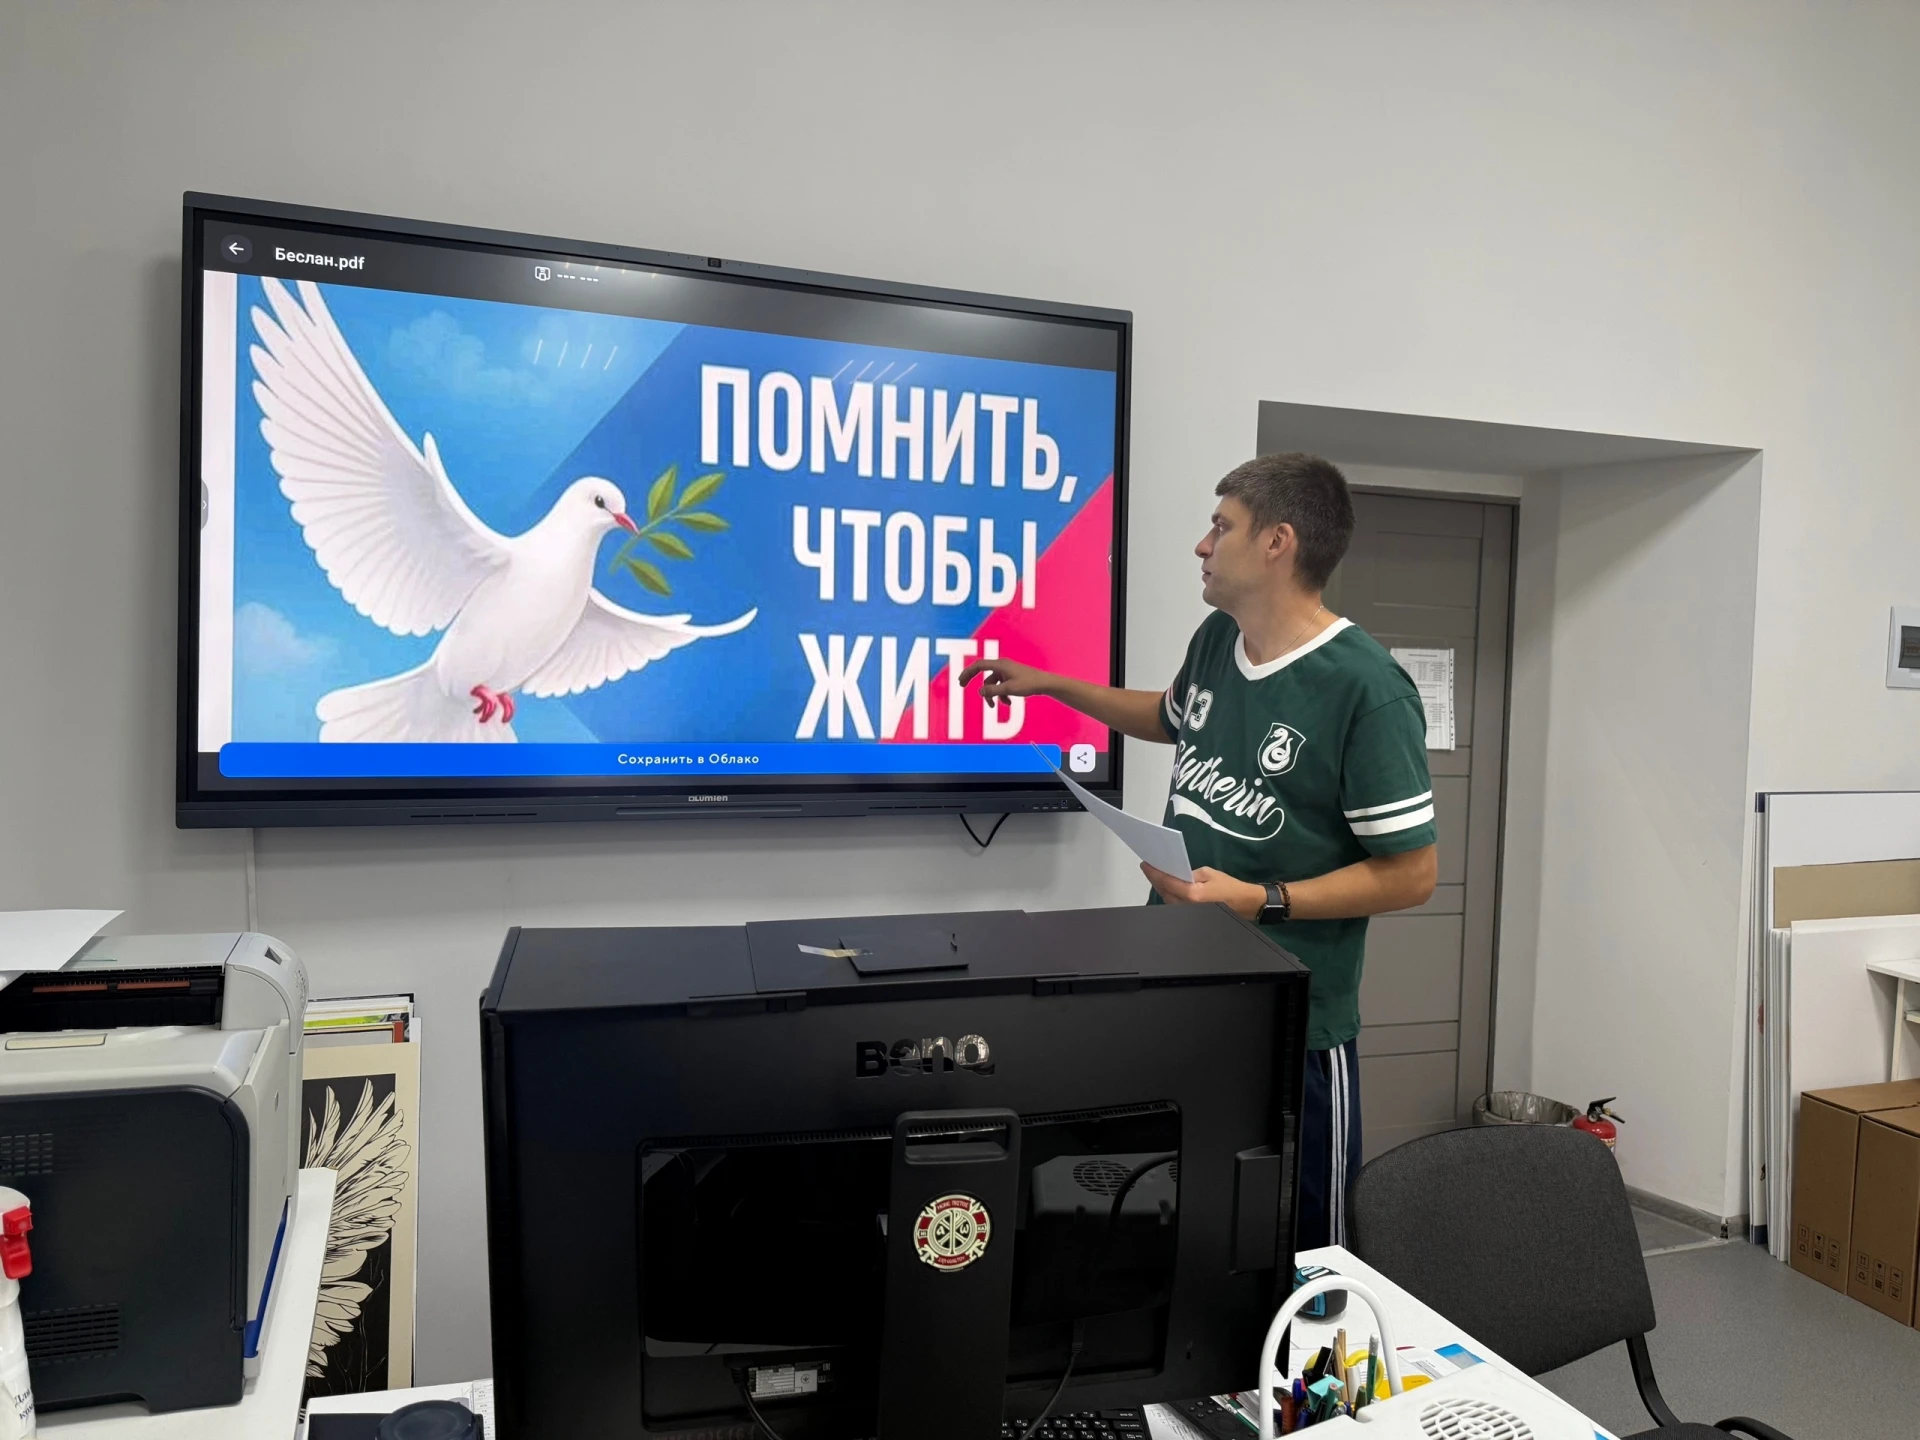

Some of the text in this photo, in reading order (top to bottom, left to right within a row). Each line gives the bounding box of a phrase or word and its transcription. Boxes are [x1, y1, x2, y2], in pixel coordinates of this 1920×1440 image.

[275, 247, 365, 271] Беслан.pdf
[701, 364, 1078, 503] ПОМНИТЬ,
[793, 505, 1037, 609] ЧТОБЫ
[795, 633, 1025, 740] ЖИТЬ
[617, 753, 760, 766] Сохранить в Облако
[856, 1034, 996, 1078] BenQ
